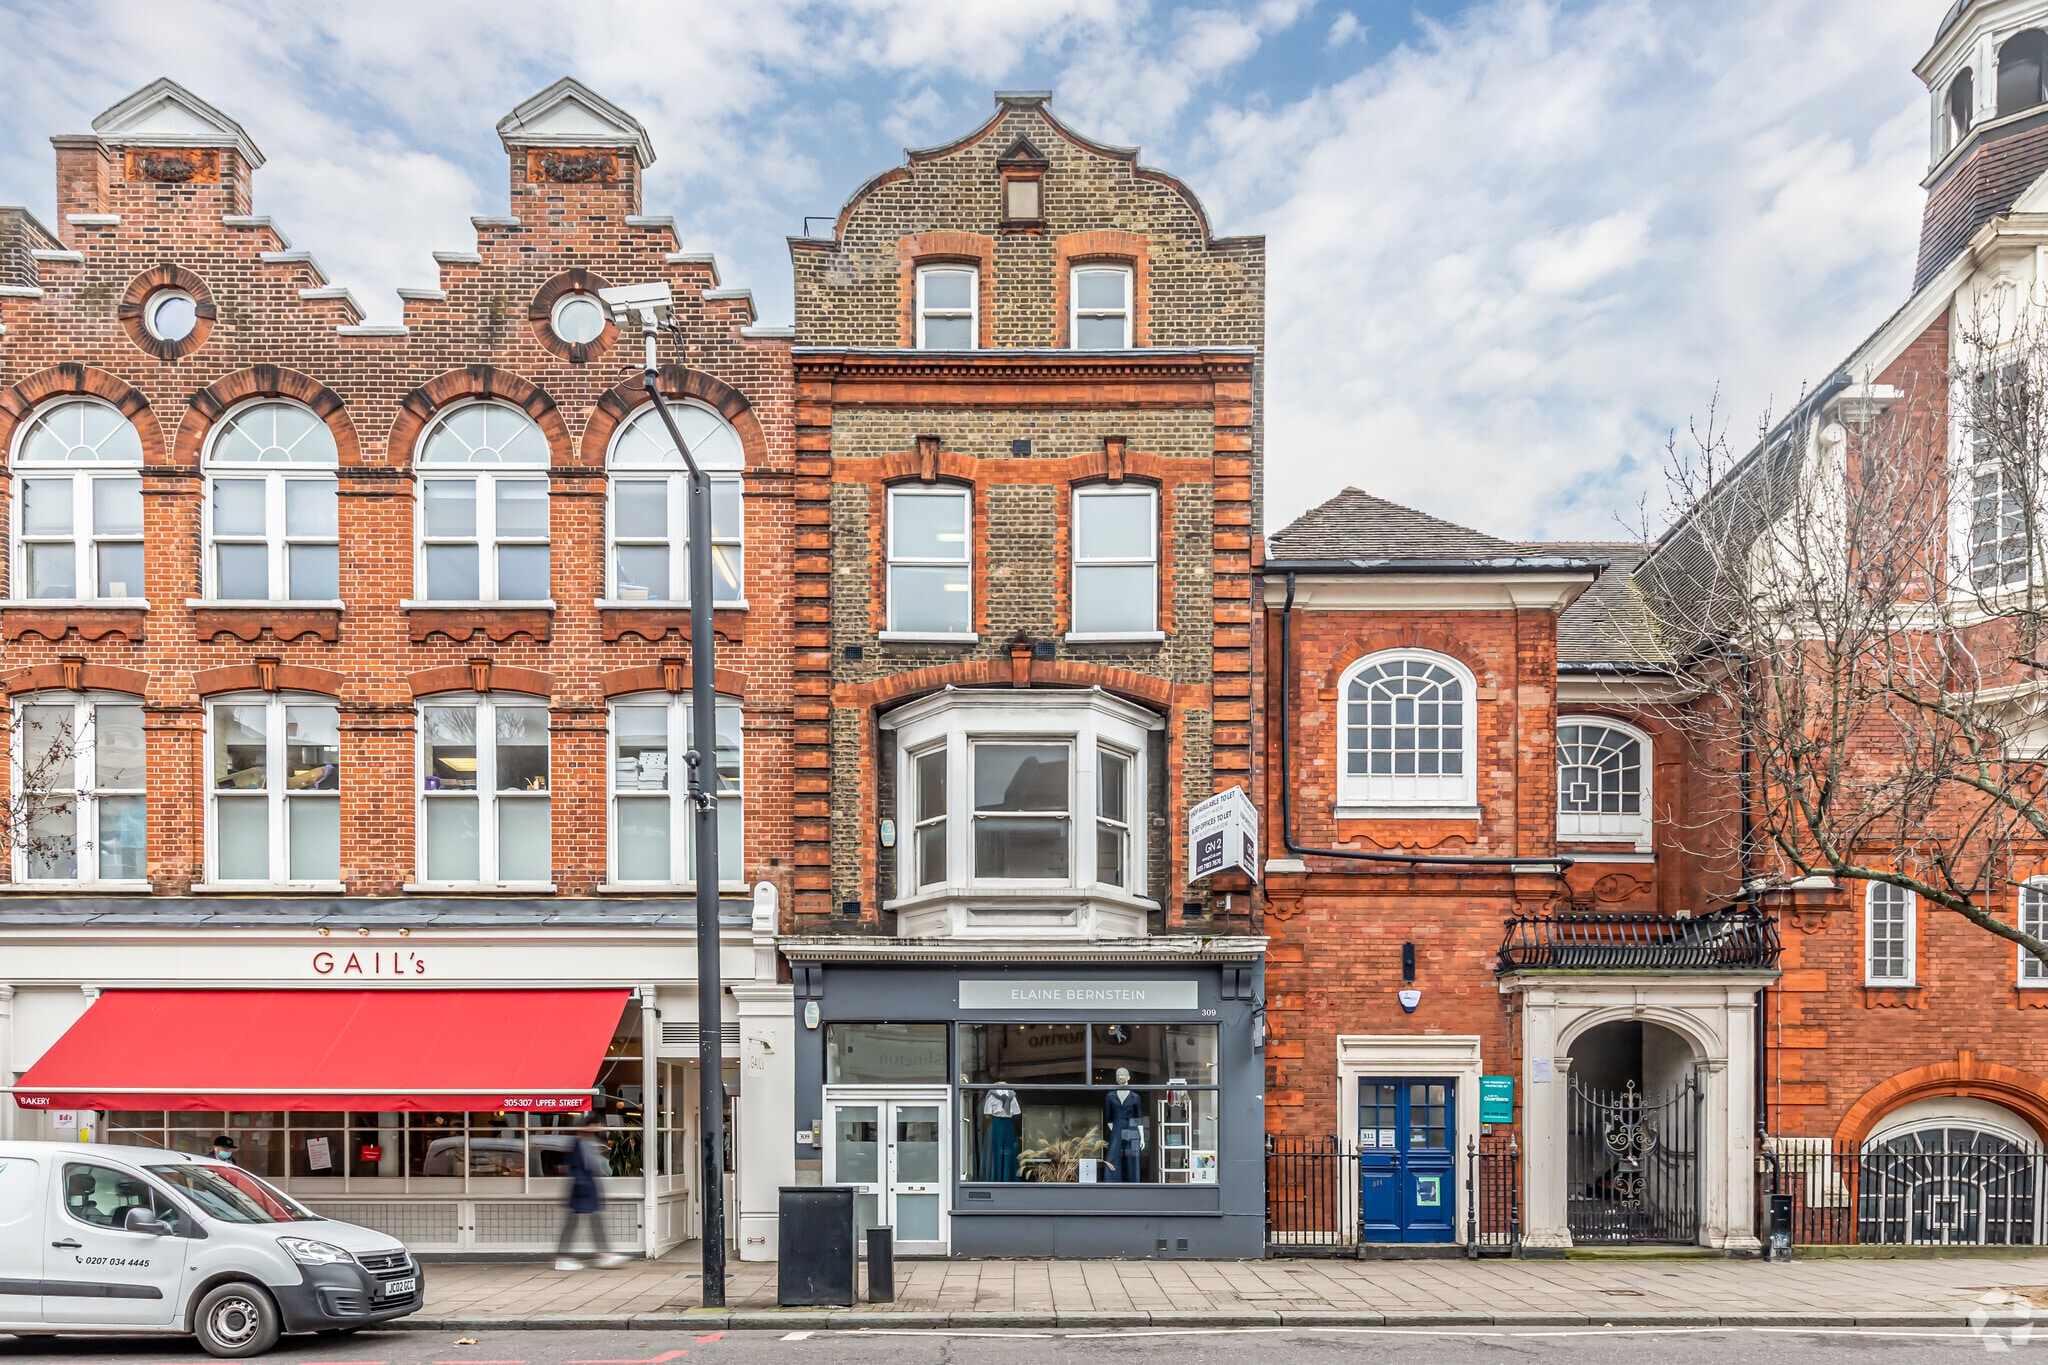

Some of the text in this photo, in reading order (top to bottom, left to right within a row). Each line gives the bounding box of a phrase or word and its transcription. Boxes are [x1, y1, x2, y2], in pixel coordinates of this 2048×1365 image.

[1199, 798, 1219, 812] AVAILABLE
[1220, 794, 1227, 802] TO
[1227, 790, 1235, 800] LET
[1201, 816, 1216, 829] OFFICES
[1217, 814, 1223, 822] TO
[1224, 810, 1232, 820] LET
[1205, 838, 1222, 853] GN 2
[313, 952, 425, 974] GAIL's
[1011, 989, 1145, 1000] ELAINE BERNSTEIN
[1201, 1009, 1216, 1017] 309
[20, 1097, 50, 1105] BAKERY
[503, 1099, 583, 1107] 305-307 UPPER STREET
[799, 1133, 811, 1142] 309
[85, 1256, 150, 1267] 0207 034 4445
